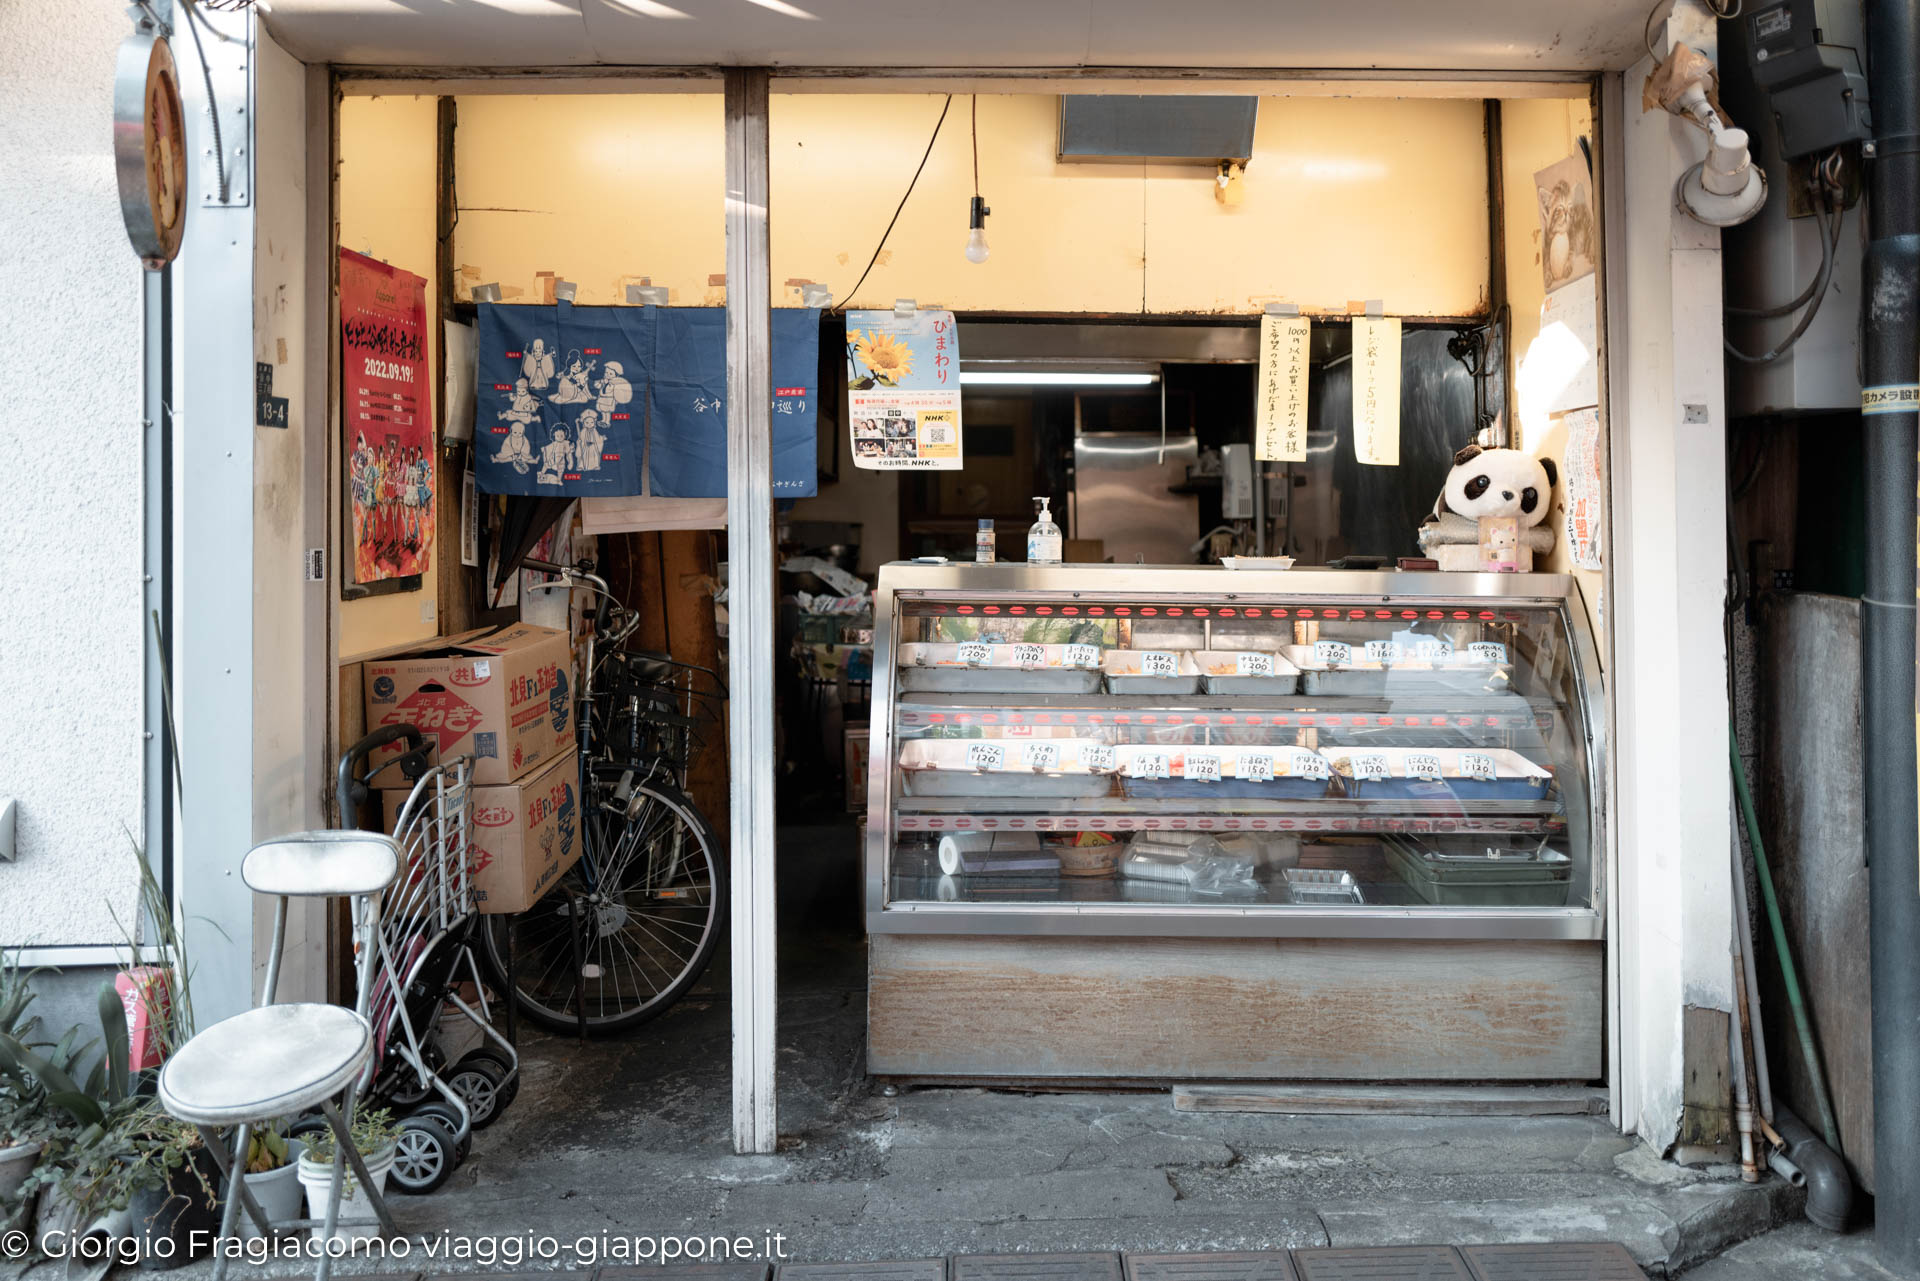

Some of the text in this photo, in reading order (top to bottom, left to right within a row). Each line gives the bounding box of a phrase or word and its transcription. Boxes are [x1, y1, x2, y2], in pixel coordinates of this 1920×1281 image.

[933, 320, 950, 384] ひまわり
[364, 357, 410, 382] 2022.09.19
[262, 401, 284, 421] 13-4
[692, 397, 721, 414] 谷中
[1575, 497, 1589, 559] 加盟店
[971, 745, 1001, 756] れんこん
[1029, 744, 1054, 754] ちくわ
